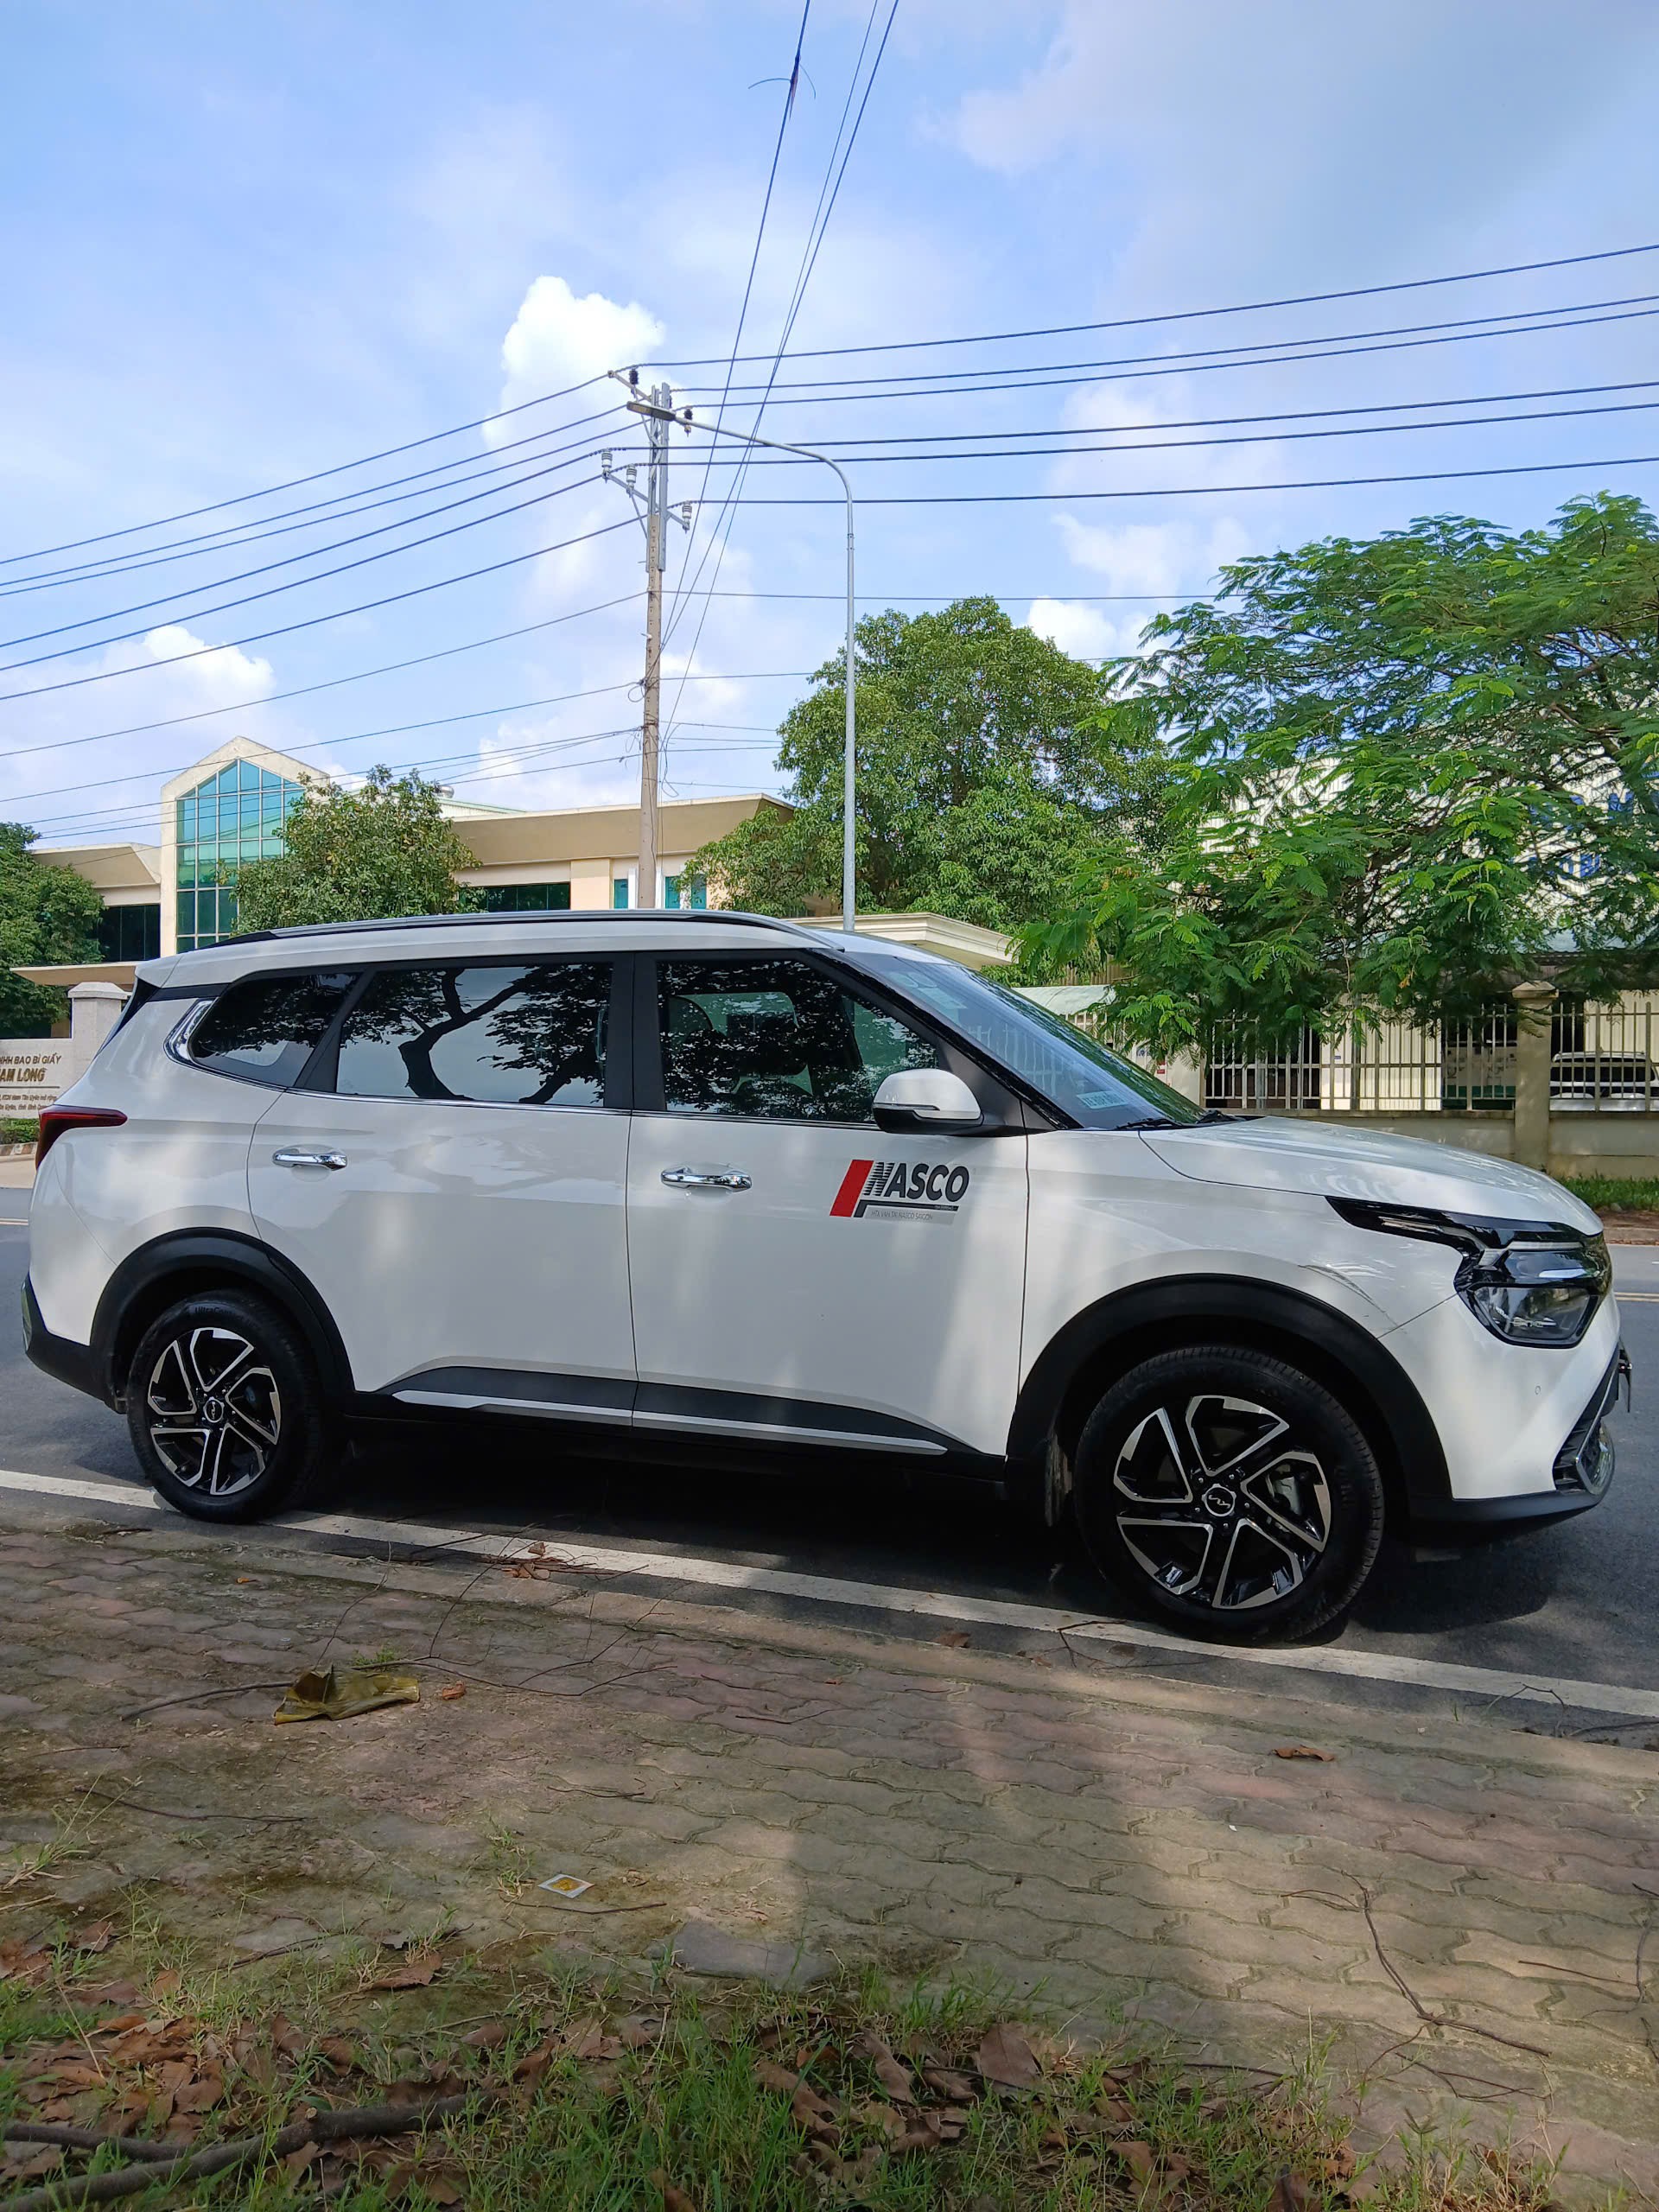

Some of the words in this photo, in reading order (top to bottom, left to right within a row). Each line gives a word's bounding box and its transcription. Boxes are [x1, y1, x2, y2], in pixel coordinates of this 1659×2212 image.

[14, 1056, 31, 1065] BAO
[41, 1052, 61, 1065] GIẤY
[0, 1068, 16, 1082] AM
[17, 1067, 47, 1082] LONG
[861, 1161, 969, 1202] NASCO
